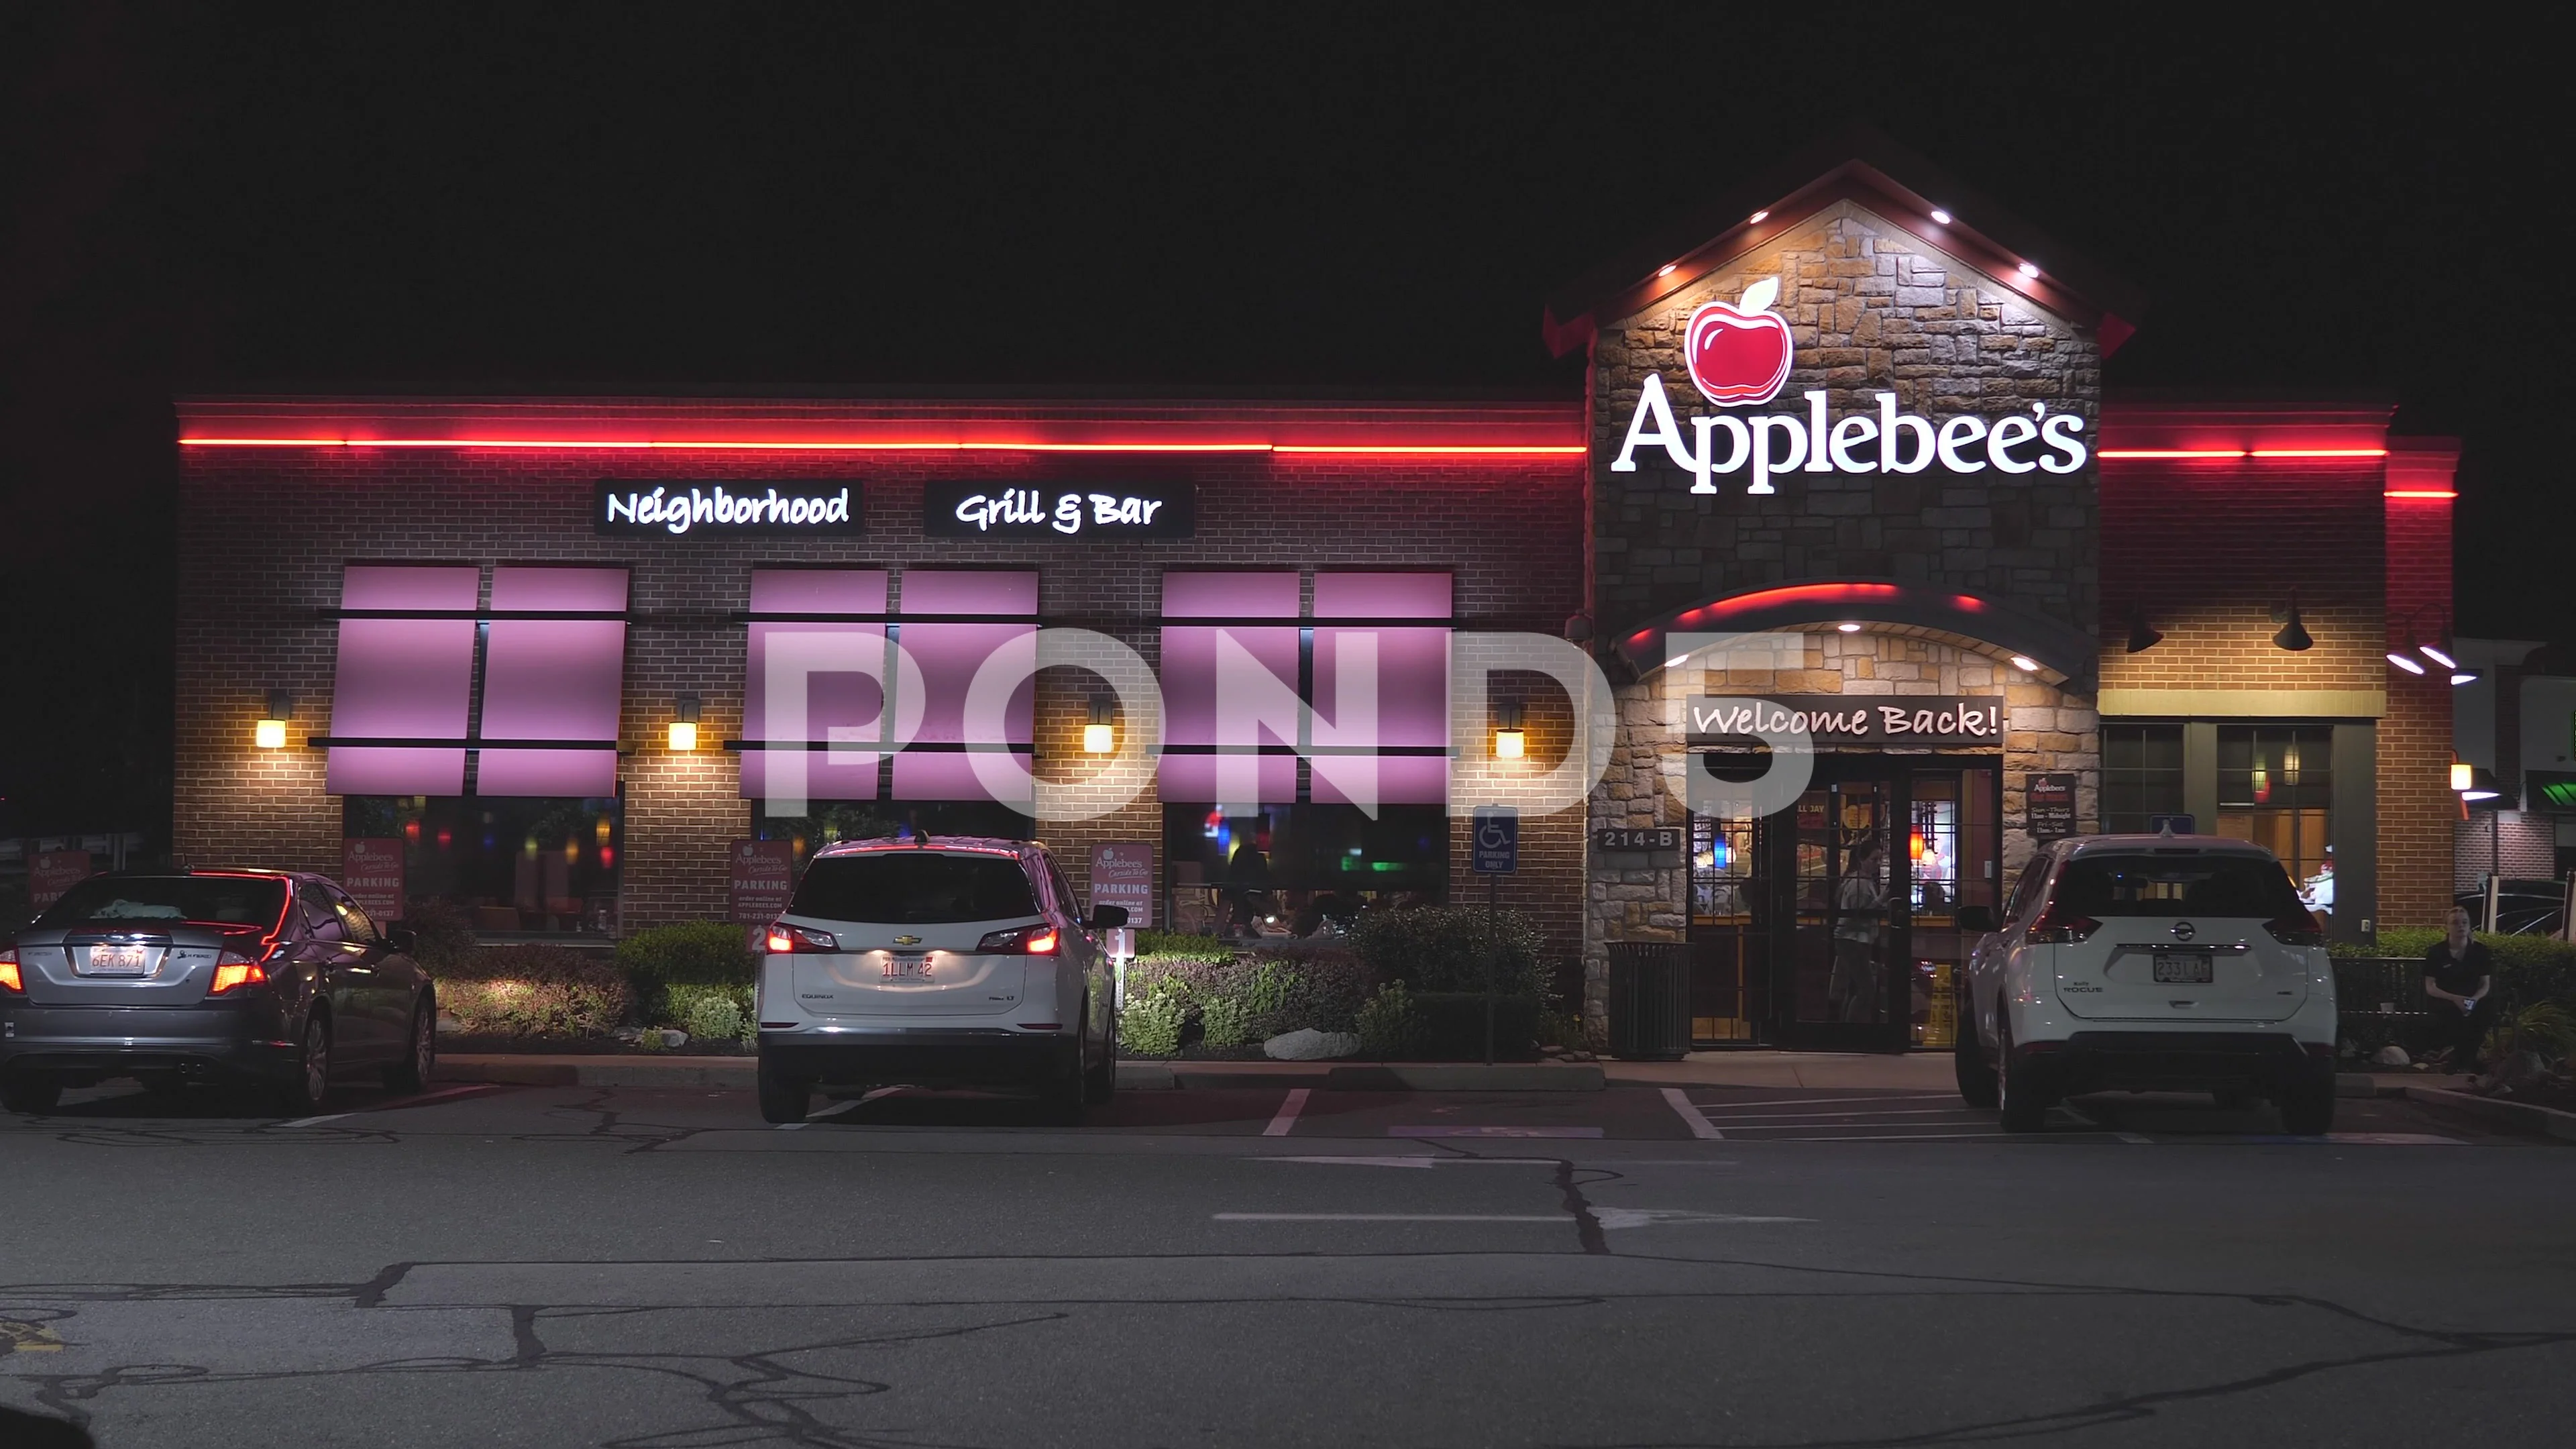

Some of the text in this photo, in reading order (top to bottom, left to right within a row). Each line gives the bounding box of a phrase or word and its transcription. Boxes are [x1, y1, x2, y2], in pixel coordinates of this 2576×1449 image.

[1611, 373, 2087, 494] Applebee's
[608, 486, 849, 534] Neighborhood
[956, 488, 1163, 534] Grill & Bar
[1693, 702, 1997, 736] Welcome Back!
[1604, 831, 1672, 847] 214-B
[1479, 851, 1510, 859] PARKING
[1485, 861, 1503, 869] ONLY
[347, 877, 399, 887] PARKING
[734, 879, 788, 891] PARKING
[1094, 883, 1148, 895] PARKING
[751, 926, 766, 951] 2
[882, 963, 932, 977] 1LLM 42
[2157, 961, 2181, 975] 233
